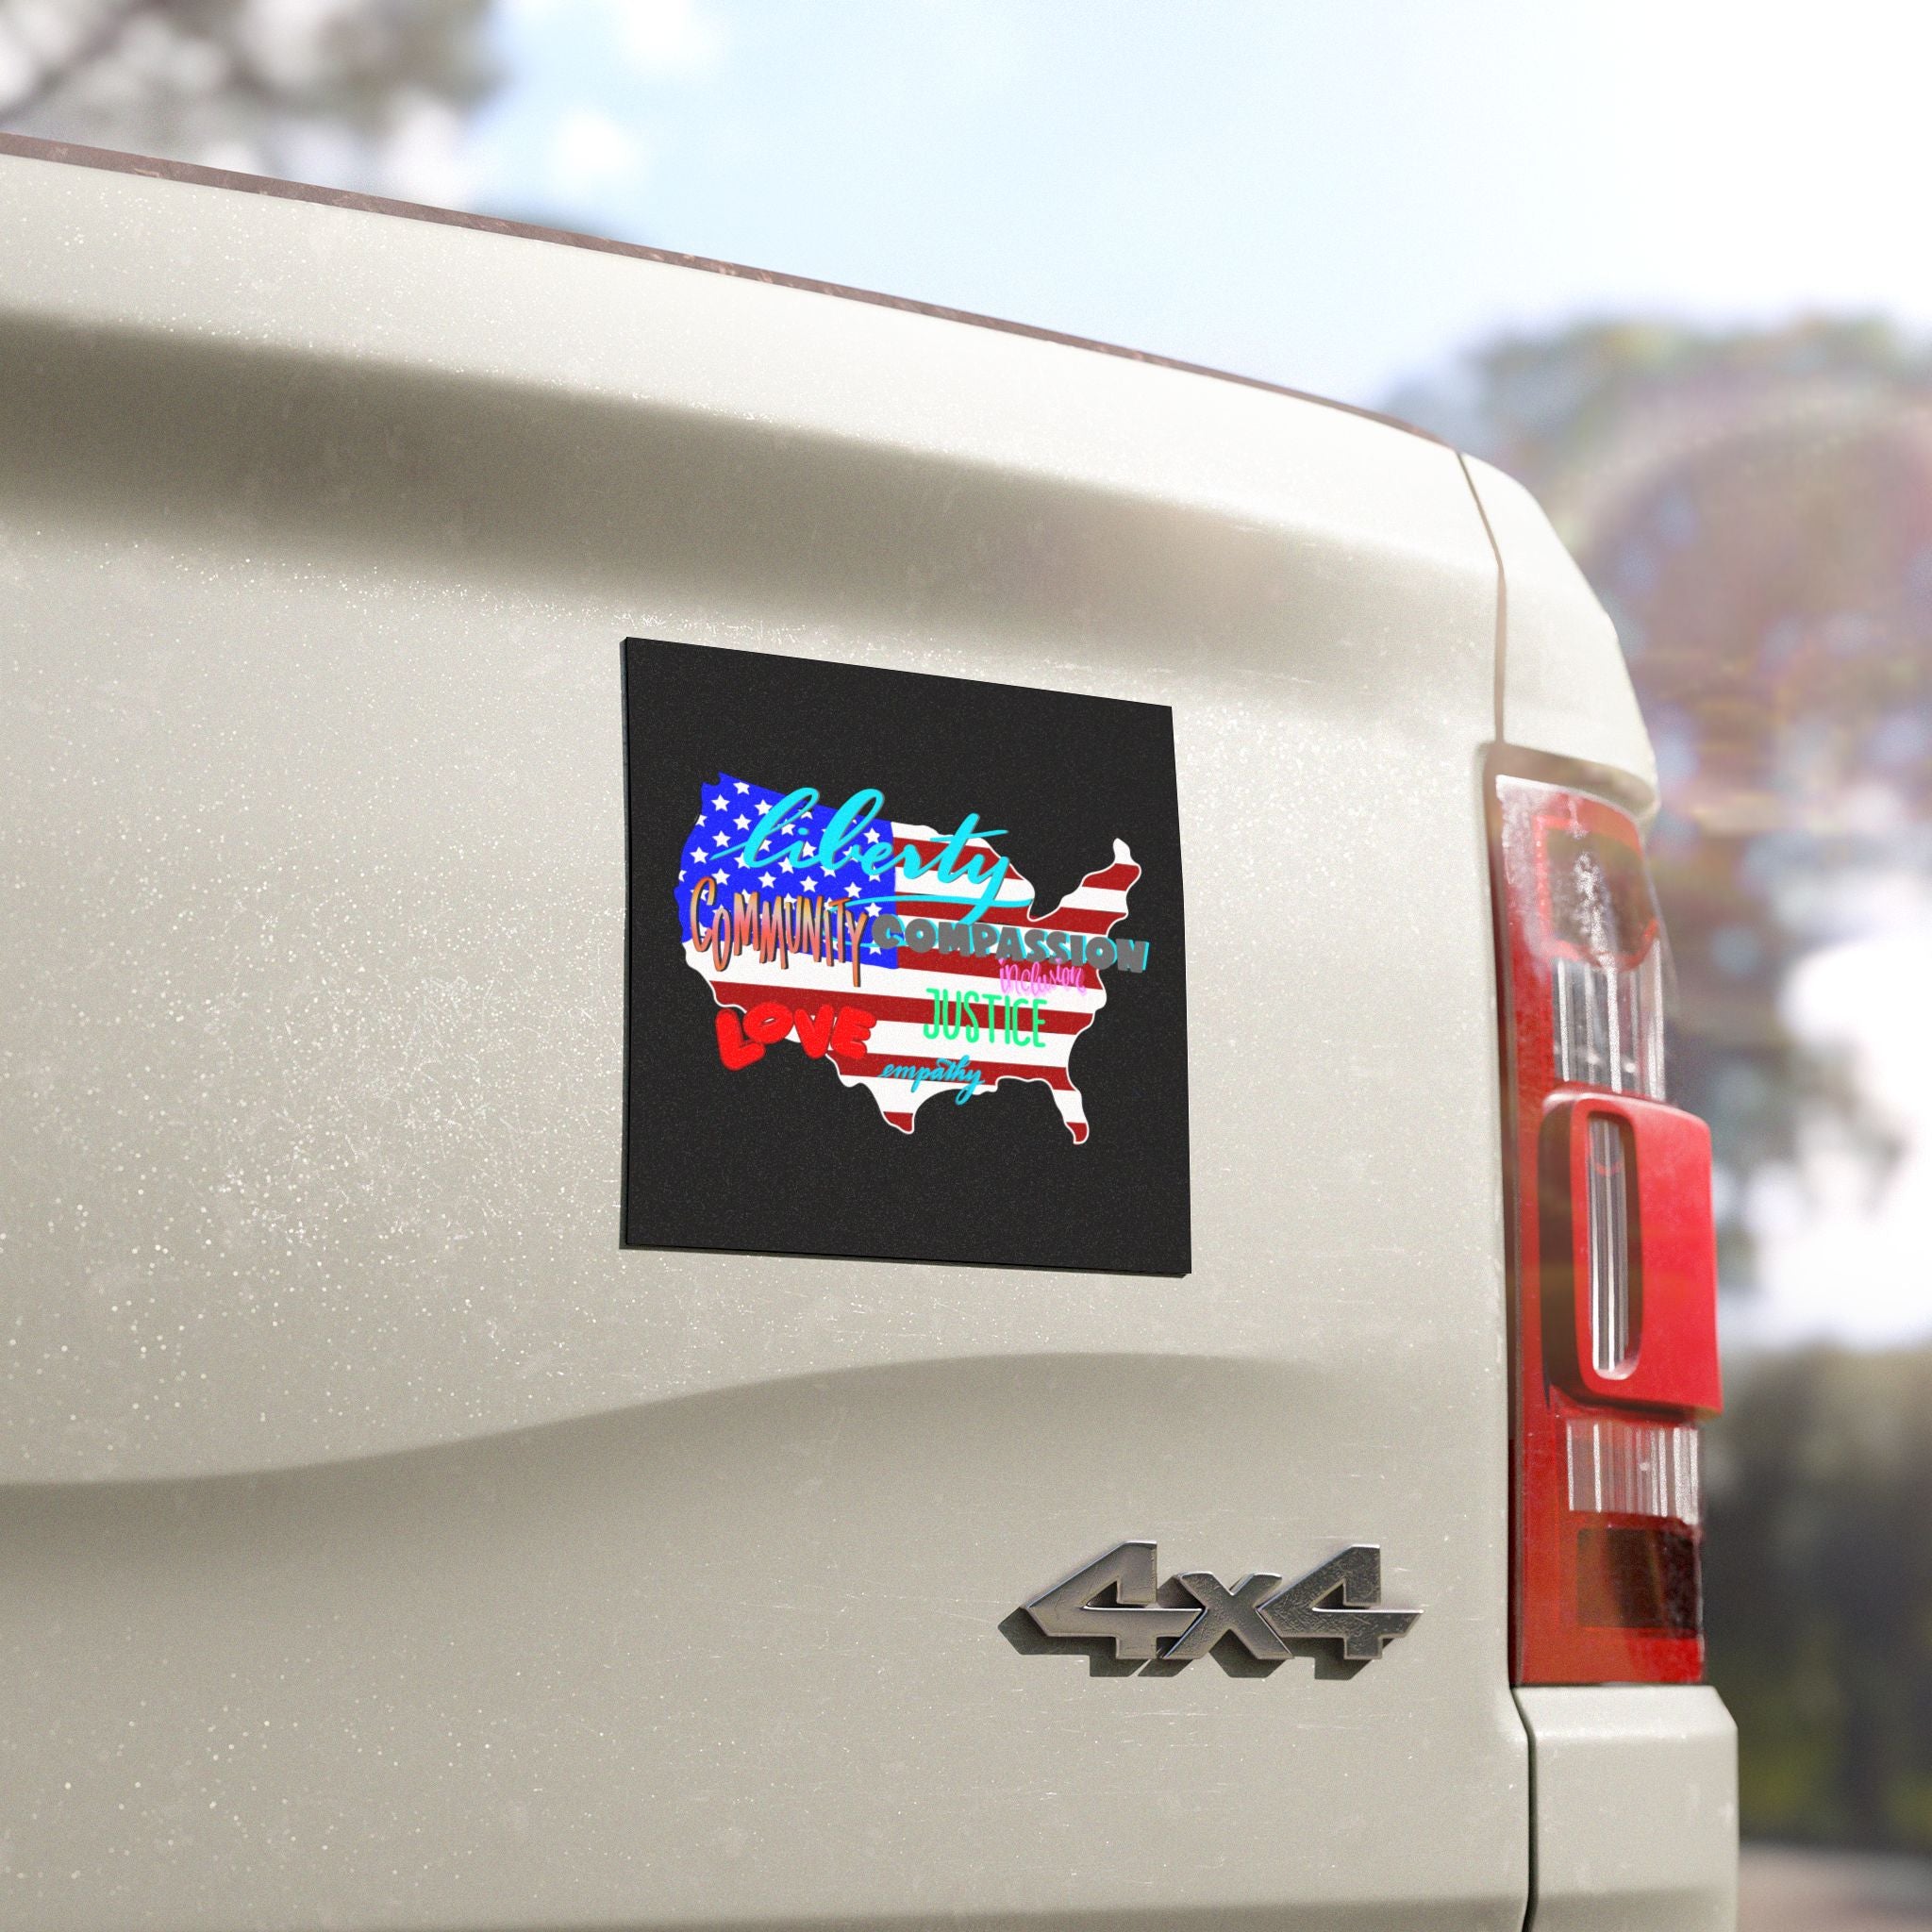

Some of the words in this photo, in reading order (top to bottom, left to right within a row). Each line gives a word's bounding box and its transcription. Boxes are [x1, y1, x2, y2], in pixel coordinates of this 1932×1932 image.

[709, 787, 1032, 925] liberty
[690, 876, 869, 987] COMMUNITY
[872, 912, 1150, 974] COMPASSION
[996, 957, 1087, 996] inclusion
[715, 1001, 877, 1071] LOVE
[923, 988, 1048, 1048] JUSTICE
[878, 1055, 985, 1106] empathy
